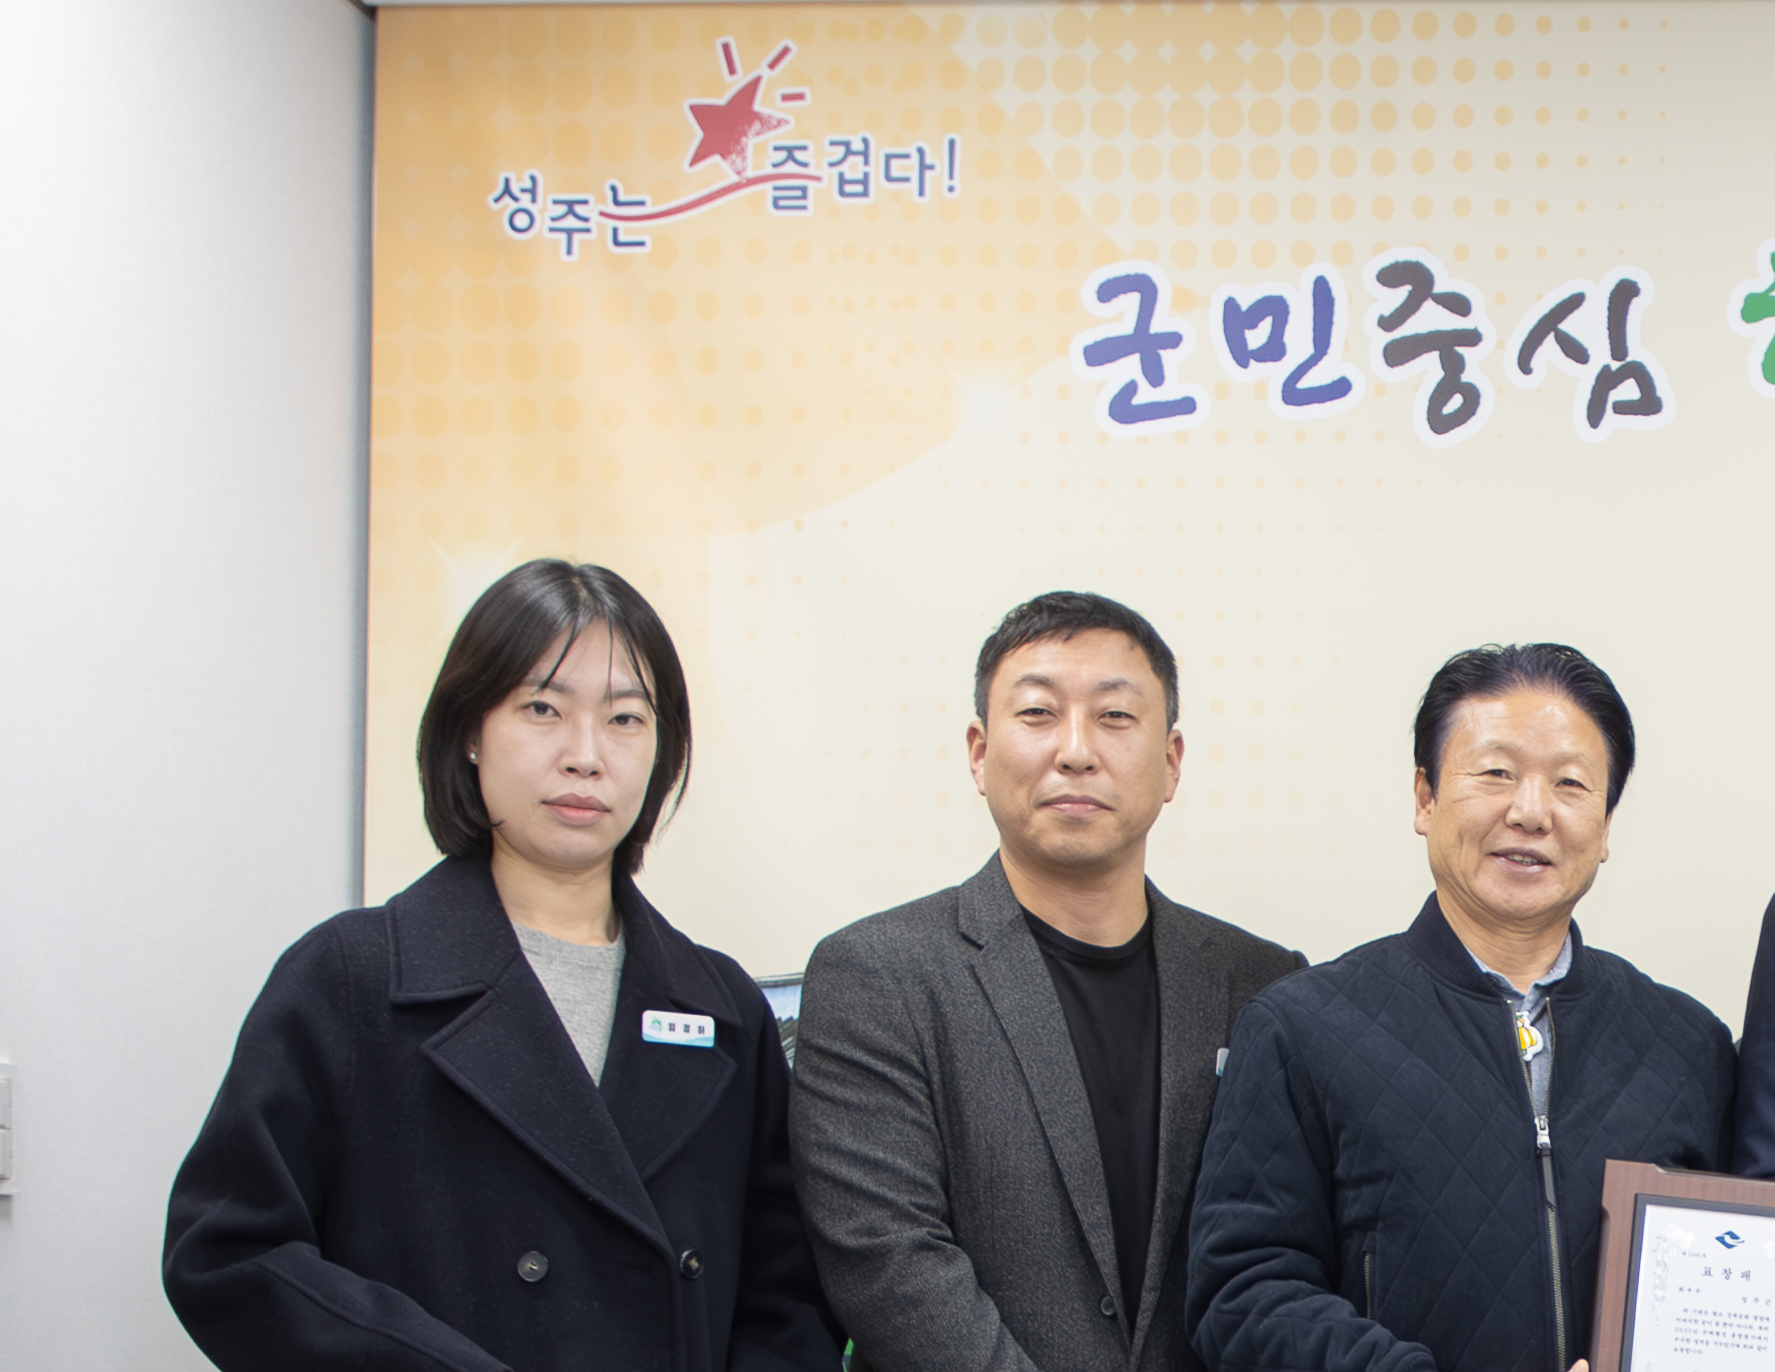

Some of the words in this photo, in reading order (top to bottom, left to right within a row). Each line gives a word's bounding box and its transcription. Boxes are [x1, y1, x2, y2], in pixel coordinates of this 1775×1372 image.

[492, 173, 647, 256] 성주는
[770, 135, 957, 211] 즐겁다!
[1083, 259, 1664, 437] 군민중심
